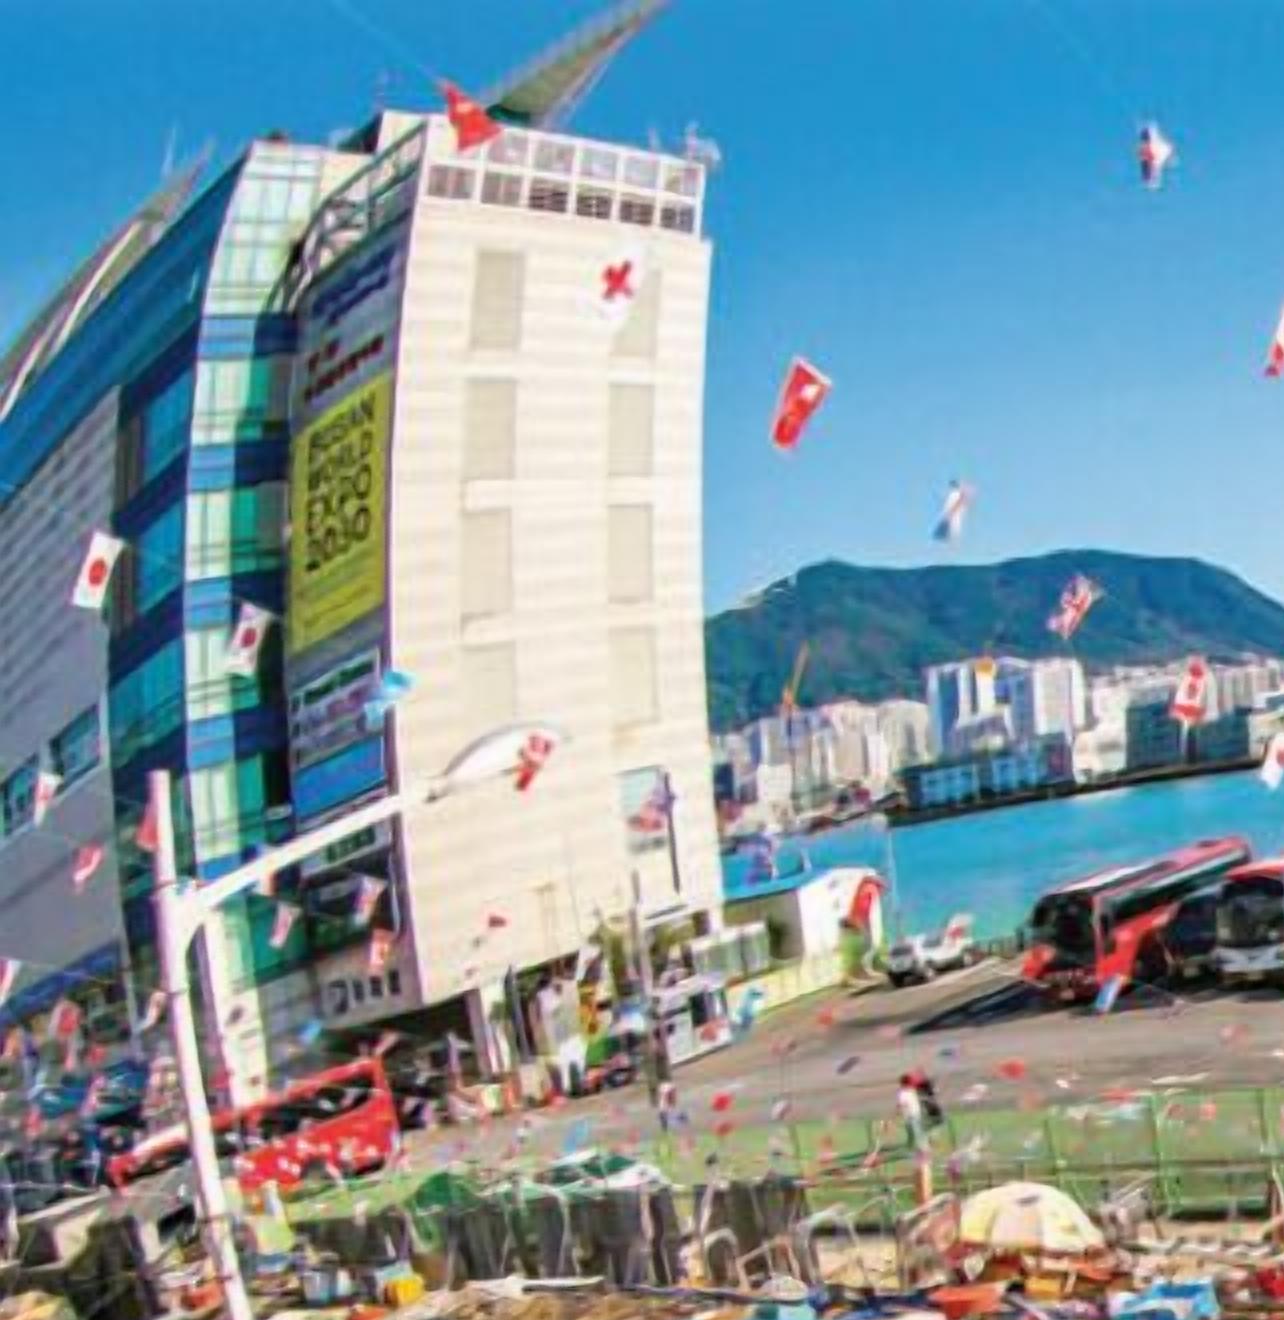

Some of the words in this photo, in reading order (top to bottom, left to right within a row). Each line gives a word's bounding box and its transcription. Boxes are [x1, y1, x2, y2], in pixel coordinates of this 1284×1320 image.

[307, 430, 373, 492] WORLD
[306, 462, 372, 537] EXPO
[305, 504, 371, 572] 2030
